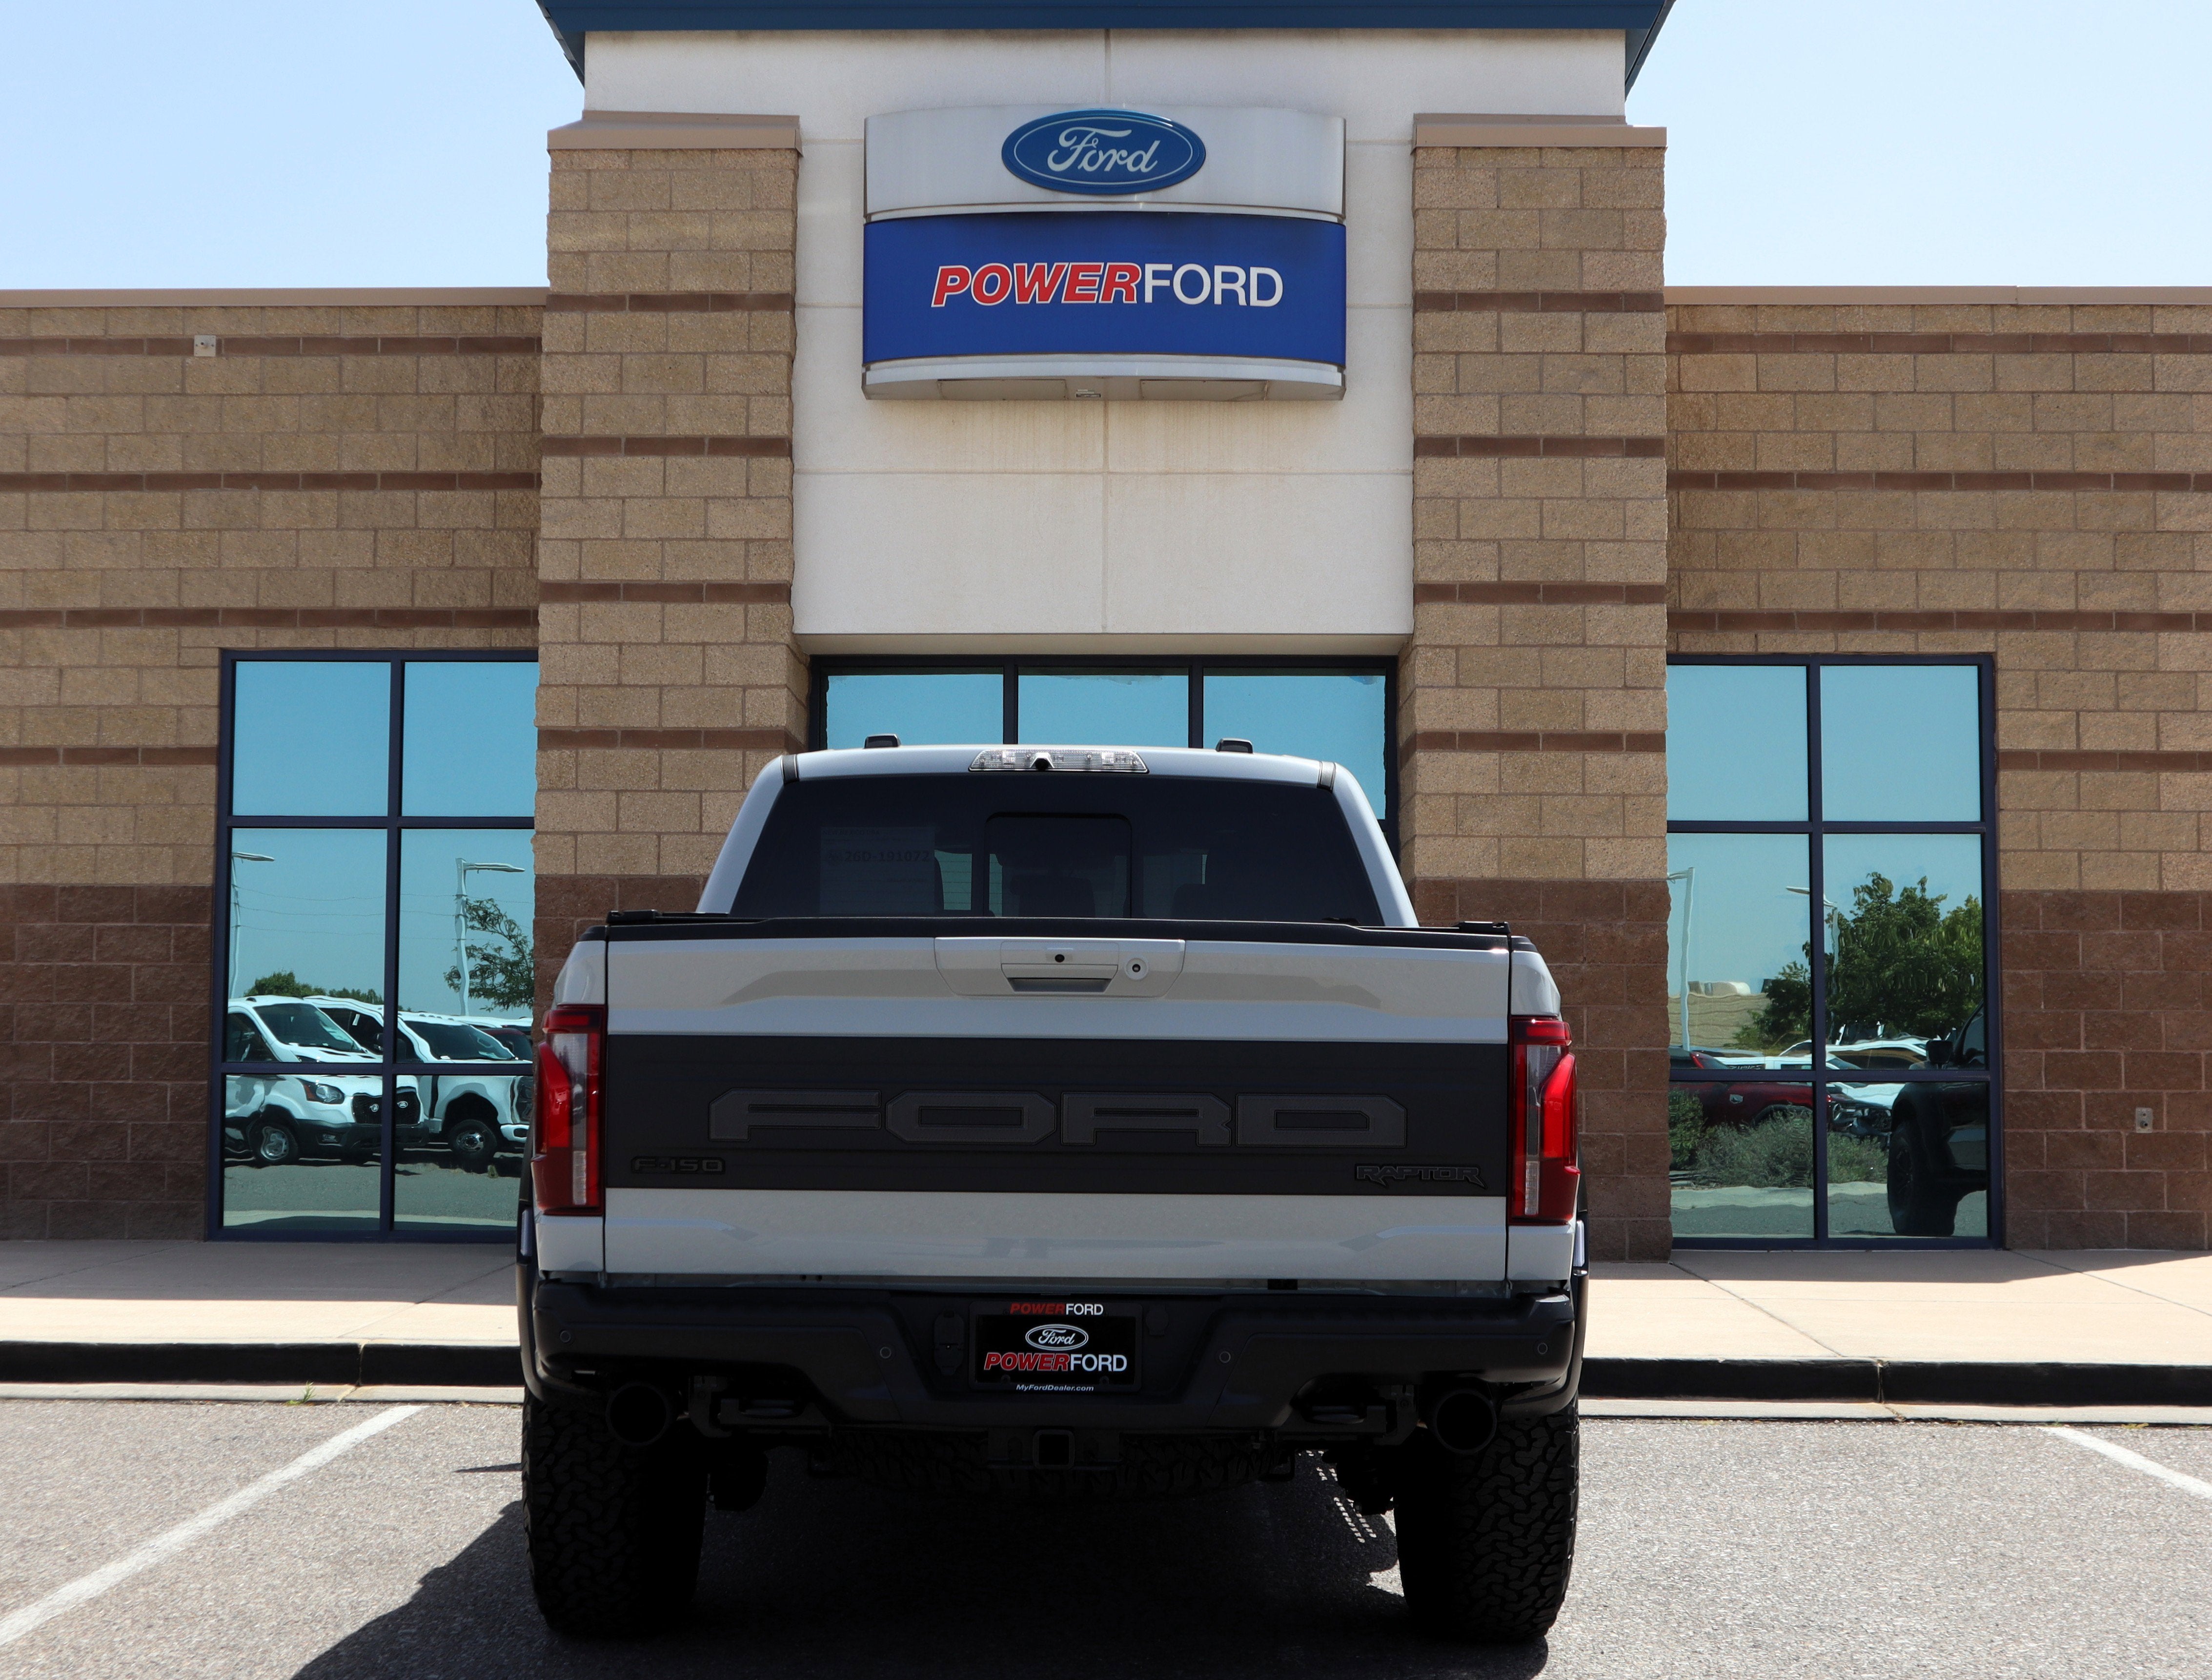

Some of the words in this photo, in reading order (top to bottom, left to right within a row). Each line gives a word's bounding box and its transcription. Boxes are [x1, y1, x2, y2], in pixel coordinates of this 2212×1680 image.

[1047, 126, 1161, 172] Ford
[931, 262, 1283, 307] POWERFORD
[844, 850, 930, 862] 26D-191072
[709, 1088, 1407, 1147] FORD
[634, 1158, 723, 1172] F-150
[1357, 1166, 1486, 1188] RAPTOR
[1009, 1302, 1104, 1315] POWERFORD
[1038, 1328, 1076, 1345] Ford
[984, 1352, 1127, 1372] POWERFORD
